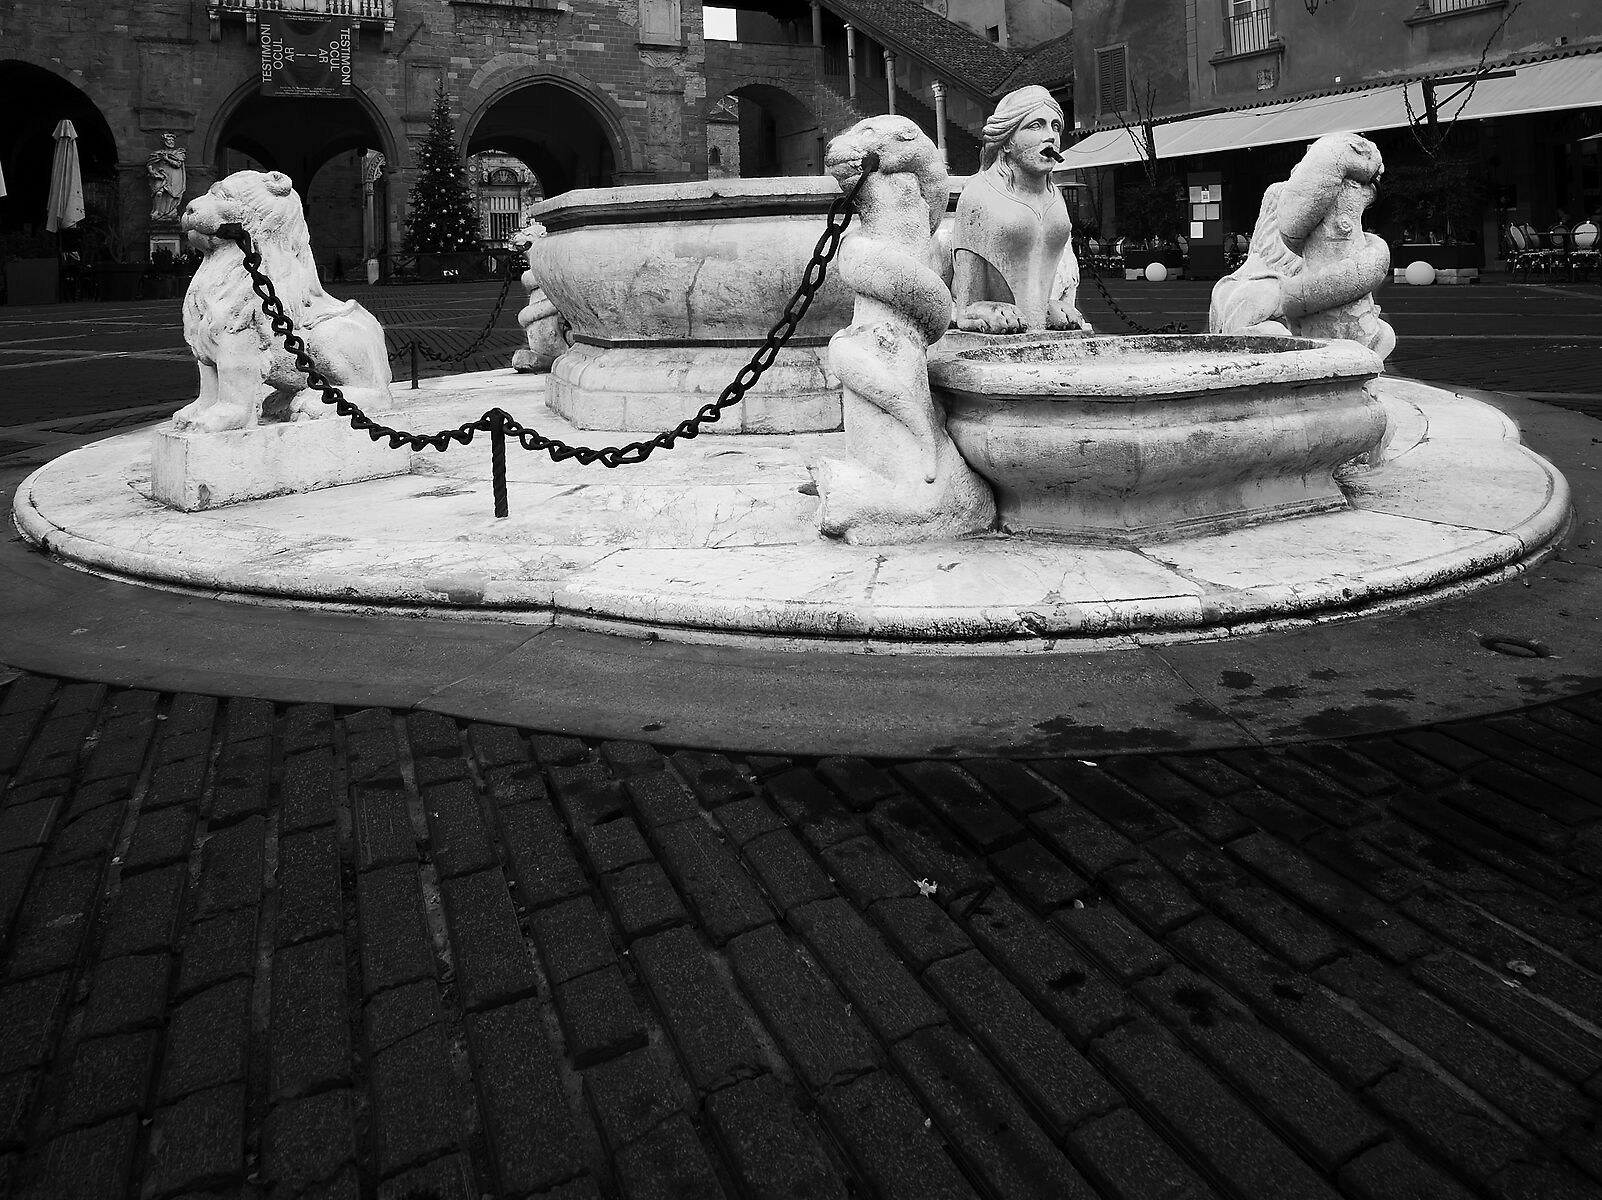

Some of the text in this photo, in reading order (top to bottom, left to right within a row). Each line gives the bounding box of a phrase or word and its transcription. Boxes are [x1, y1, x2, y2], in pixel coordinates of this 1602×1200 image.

[261, 23, 272, 83] TESTIMONI
[272, 38, 284, 70] OCUL
[284, 47, 295, 63] AR
[318, 48, 329, 63] AR
[329, 40, 340, 72] OCUL
[340, 27, 351, 86] TESTIMONI
